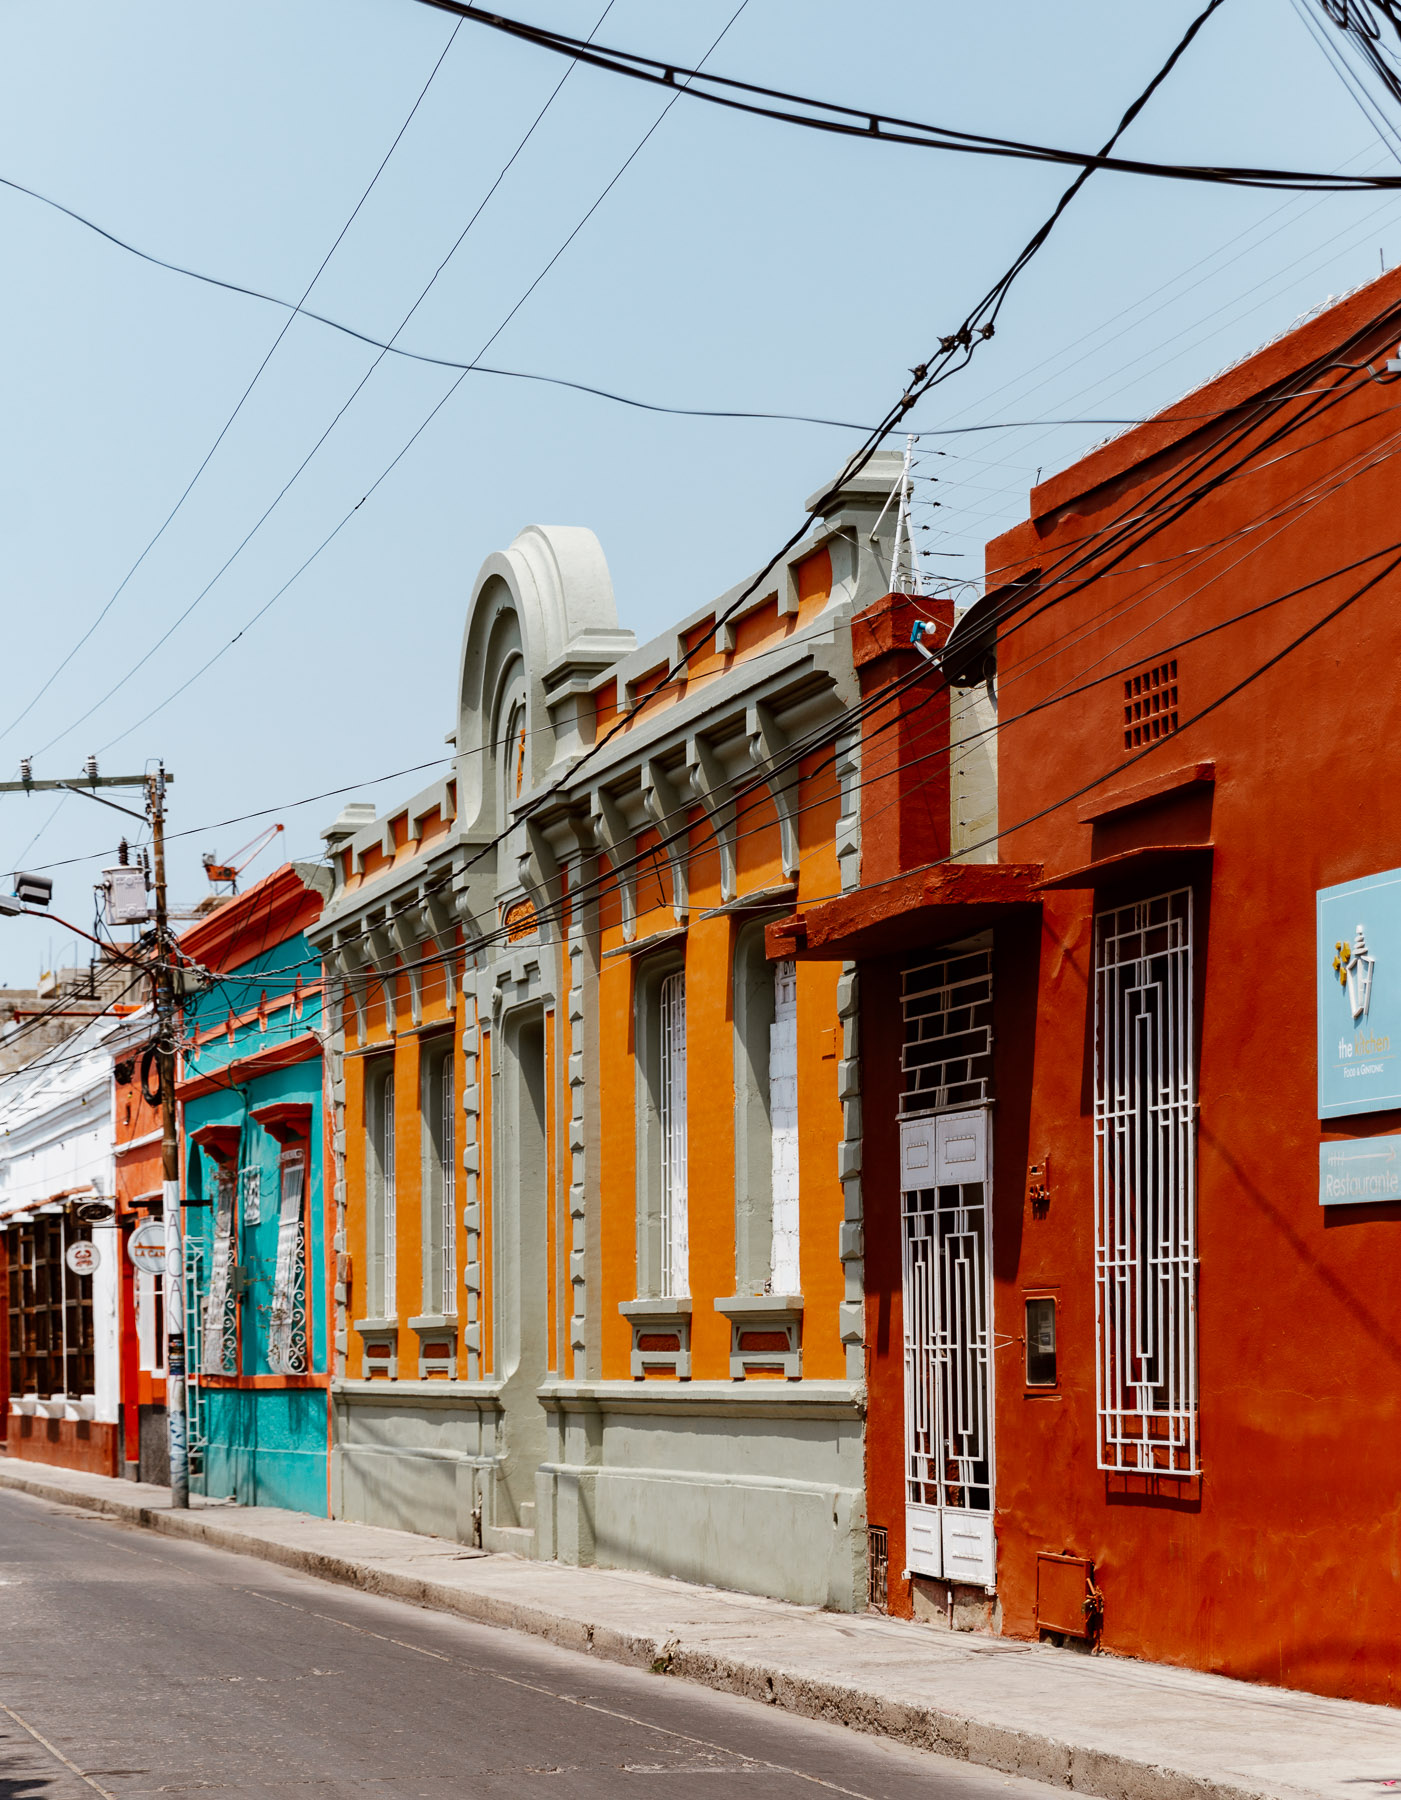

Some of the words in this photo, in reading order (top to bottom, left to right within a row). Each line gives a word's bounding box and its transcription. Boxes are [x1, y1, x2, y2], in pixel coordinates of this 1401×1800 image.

[1338, 1037, 1353, 1060] the
[1354, 1030, 1390, 1057] kitchen
[1325, 1171, 1399, 1198] Restaurante
[134, 1248, 145, 1257] LA
[147, 1248, 166, 1258] CAN
